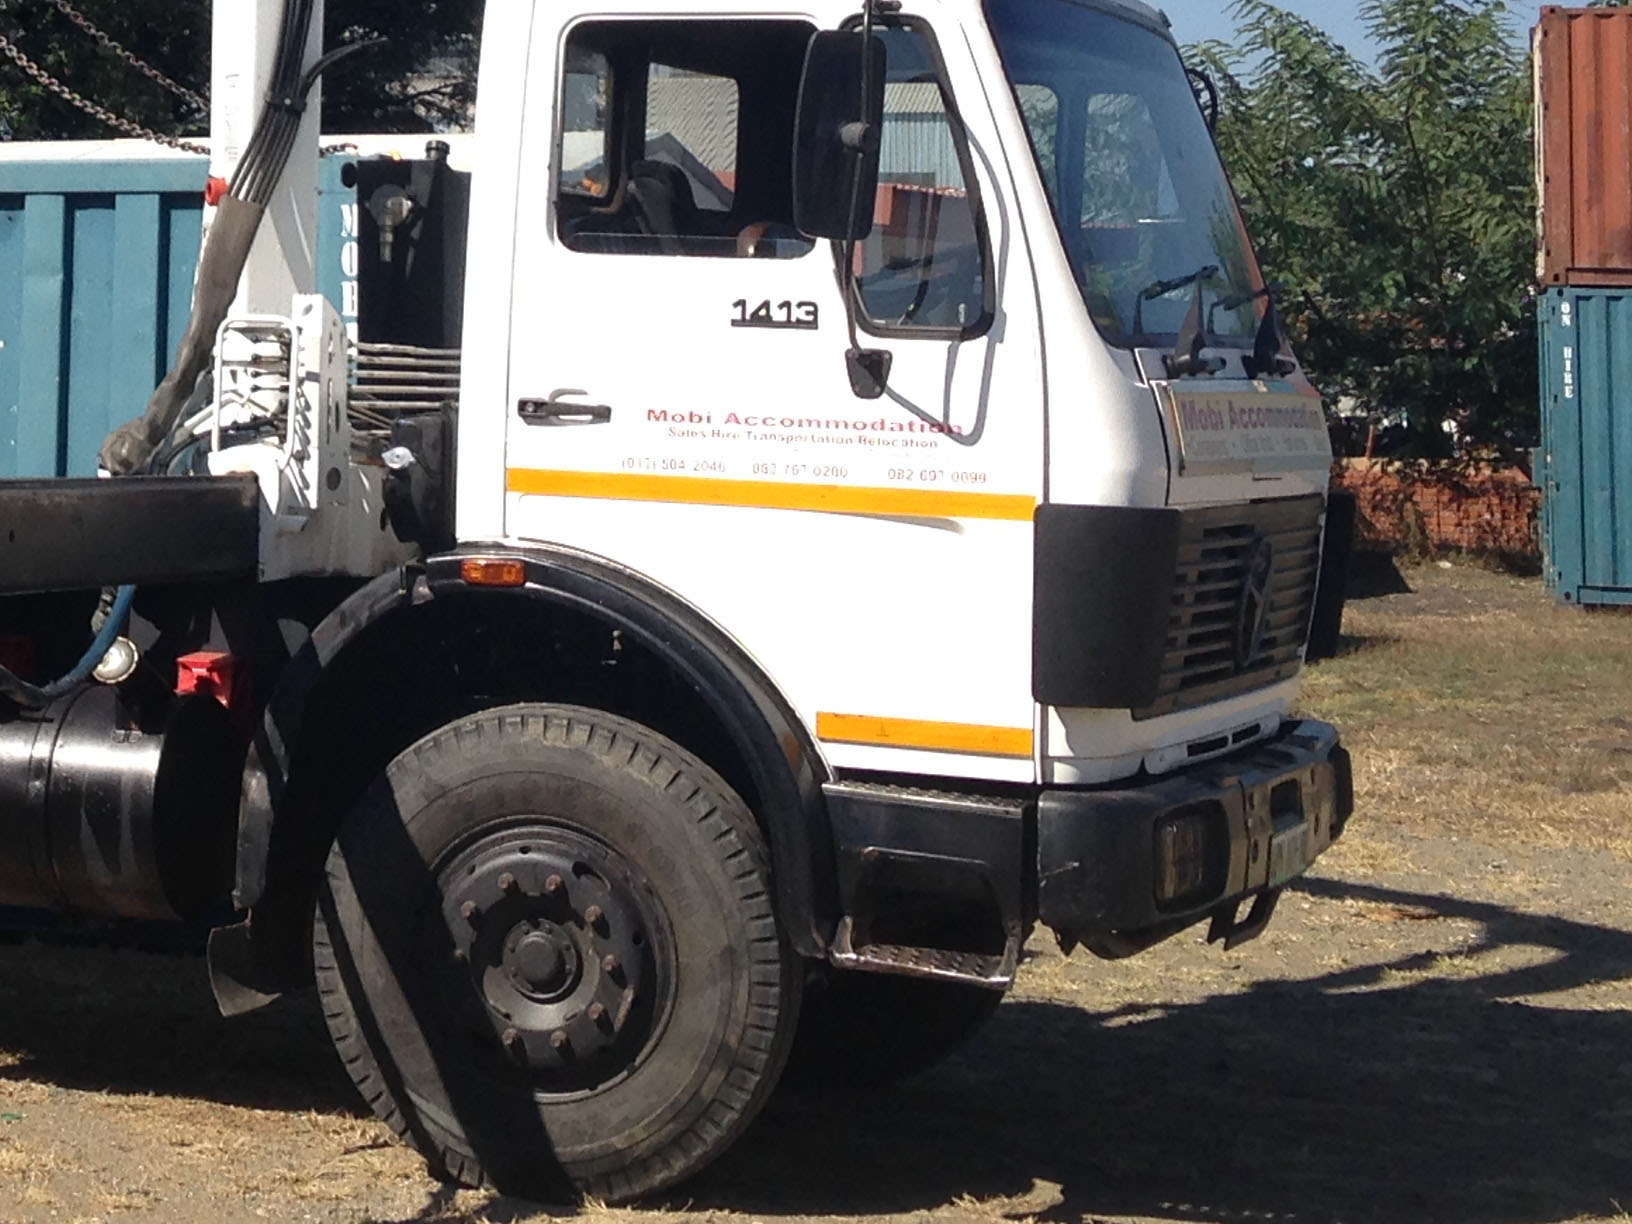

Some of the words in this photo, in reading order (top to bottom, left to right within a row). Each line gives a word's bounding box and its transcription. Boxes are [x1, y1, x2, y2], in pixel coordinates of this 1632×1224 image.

[731, 299, 819, 325] 1413
[647, 408, 712, 424] Mobi
[724, 412, 964, 437] Accommodation
